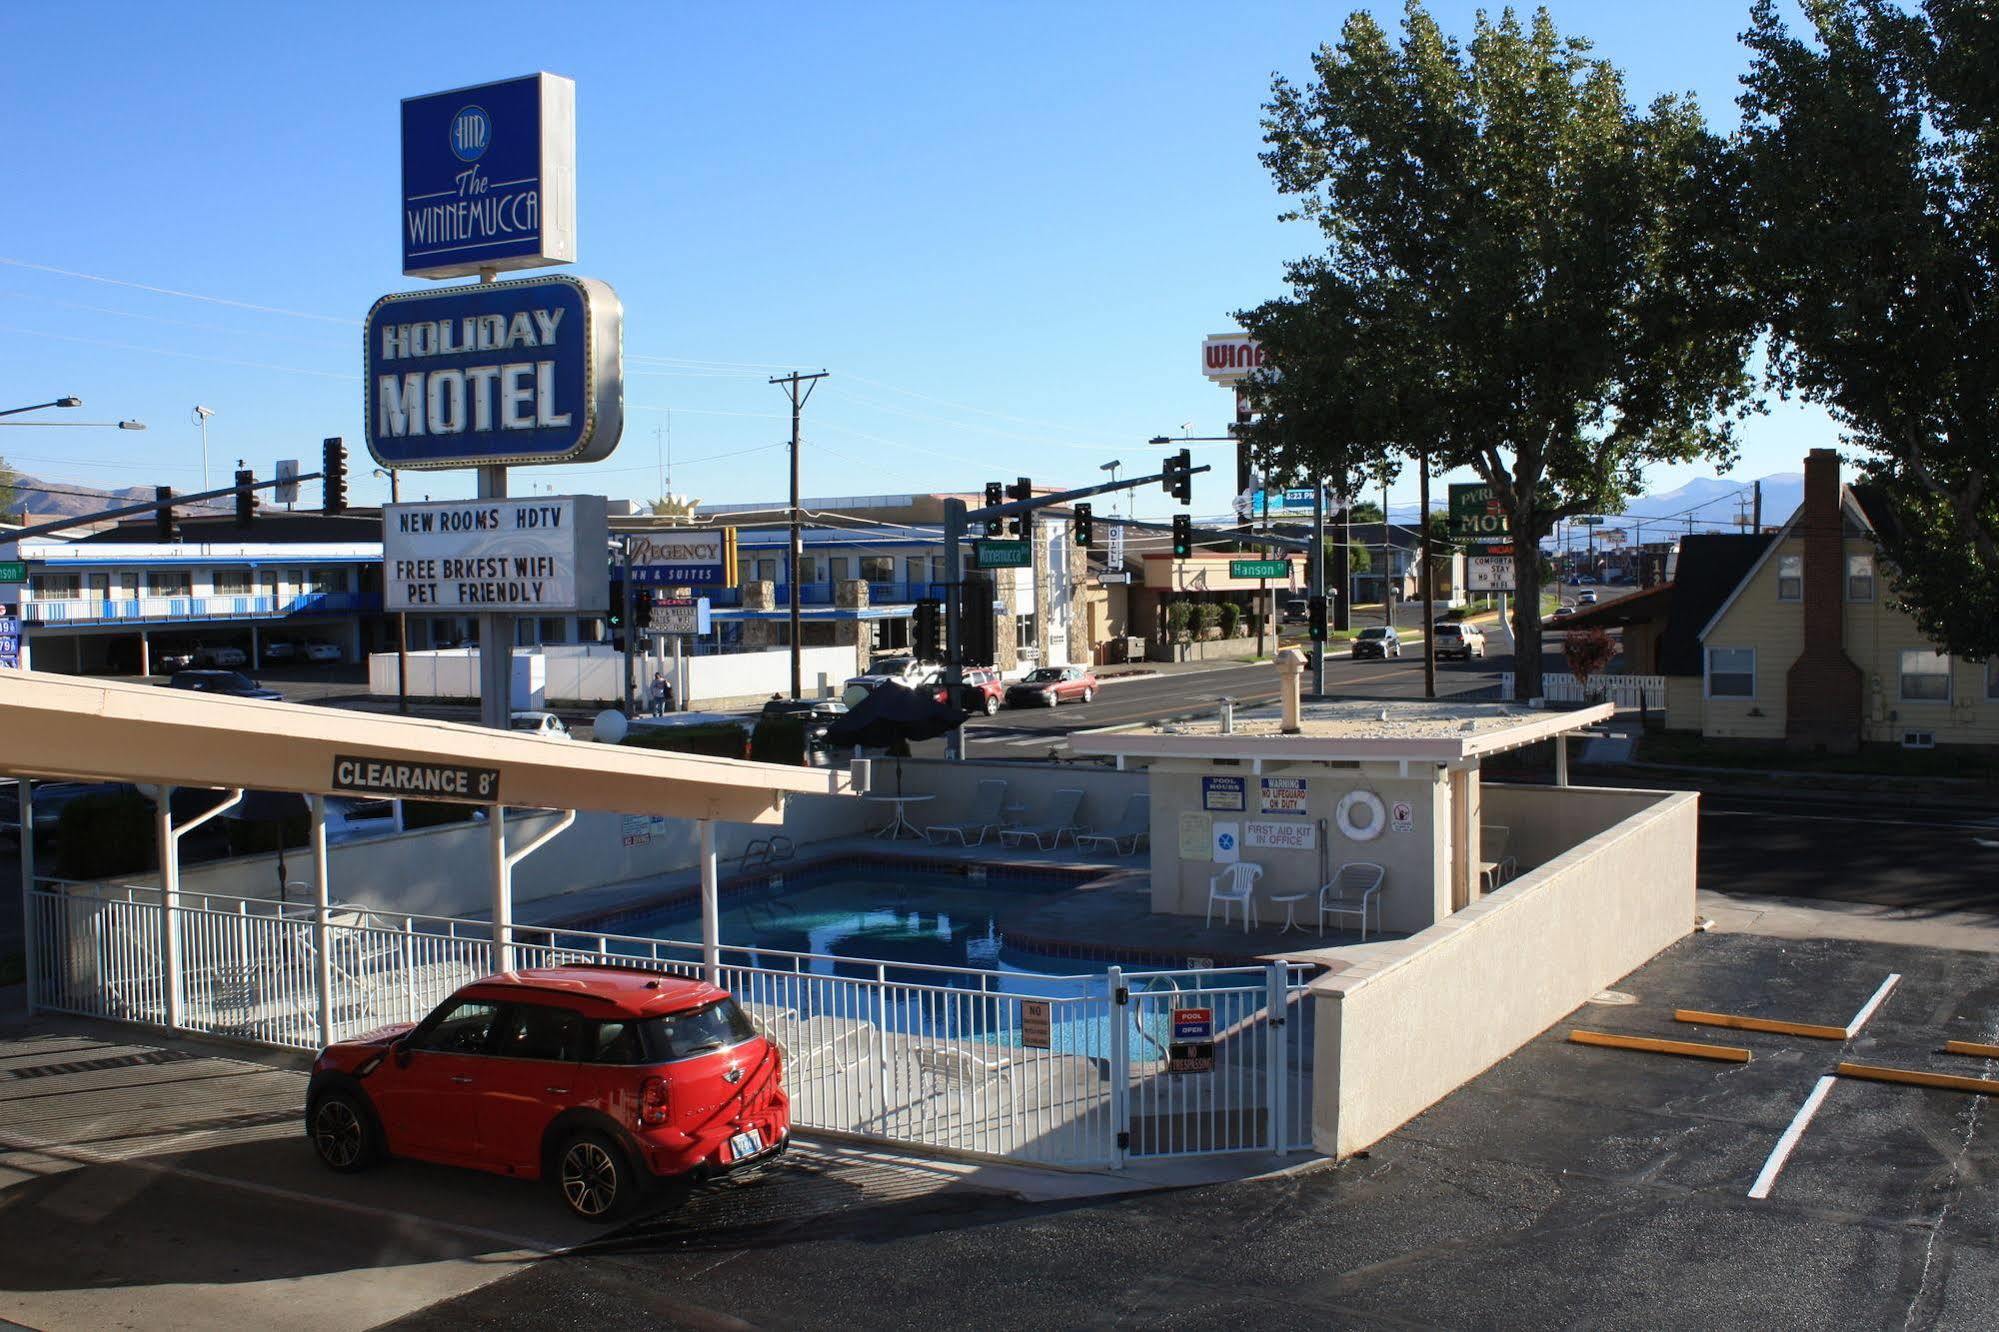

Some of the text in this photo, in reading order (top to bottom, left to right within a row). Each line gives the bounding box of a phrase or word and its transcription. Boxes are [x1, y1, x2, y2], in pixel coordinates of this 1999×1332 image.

[456, 164, 489, 197] The
[407, 191, 538, 246] WINNEMUCCA
[382, 307, 566, 360] HOLIDAY
[378, 360, 573, 438] MOTEL
[400, 507, 561, 532] NEW ROOMS HDTV
[396, 556, 554, 580] FREE BRKFST WIFI
[668, 569, 712, 580] SUITES
[1234, 563, 1274, 576] Hanson
[407, 581, 543, 603] PET FRIENDLY
[338, 761, 496, 795] CLEARANCE 8'
[1267, 779, 1299, 789] WARNING
[1209, 783, 1240, 791] HOURS
[1262, 789, 1306, 799] NO LIFEGUARD
[1269, 800, 1298, 809] ON DUTY
[1248, 824, 1311, 837] FIRST AID KIT
[1256, 835, 1303, 846] IN OFFICE
[1029, 1005, 1042, 1016] NO
